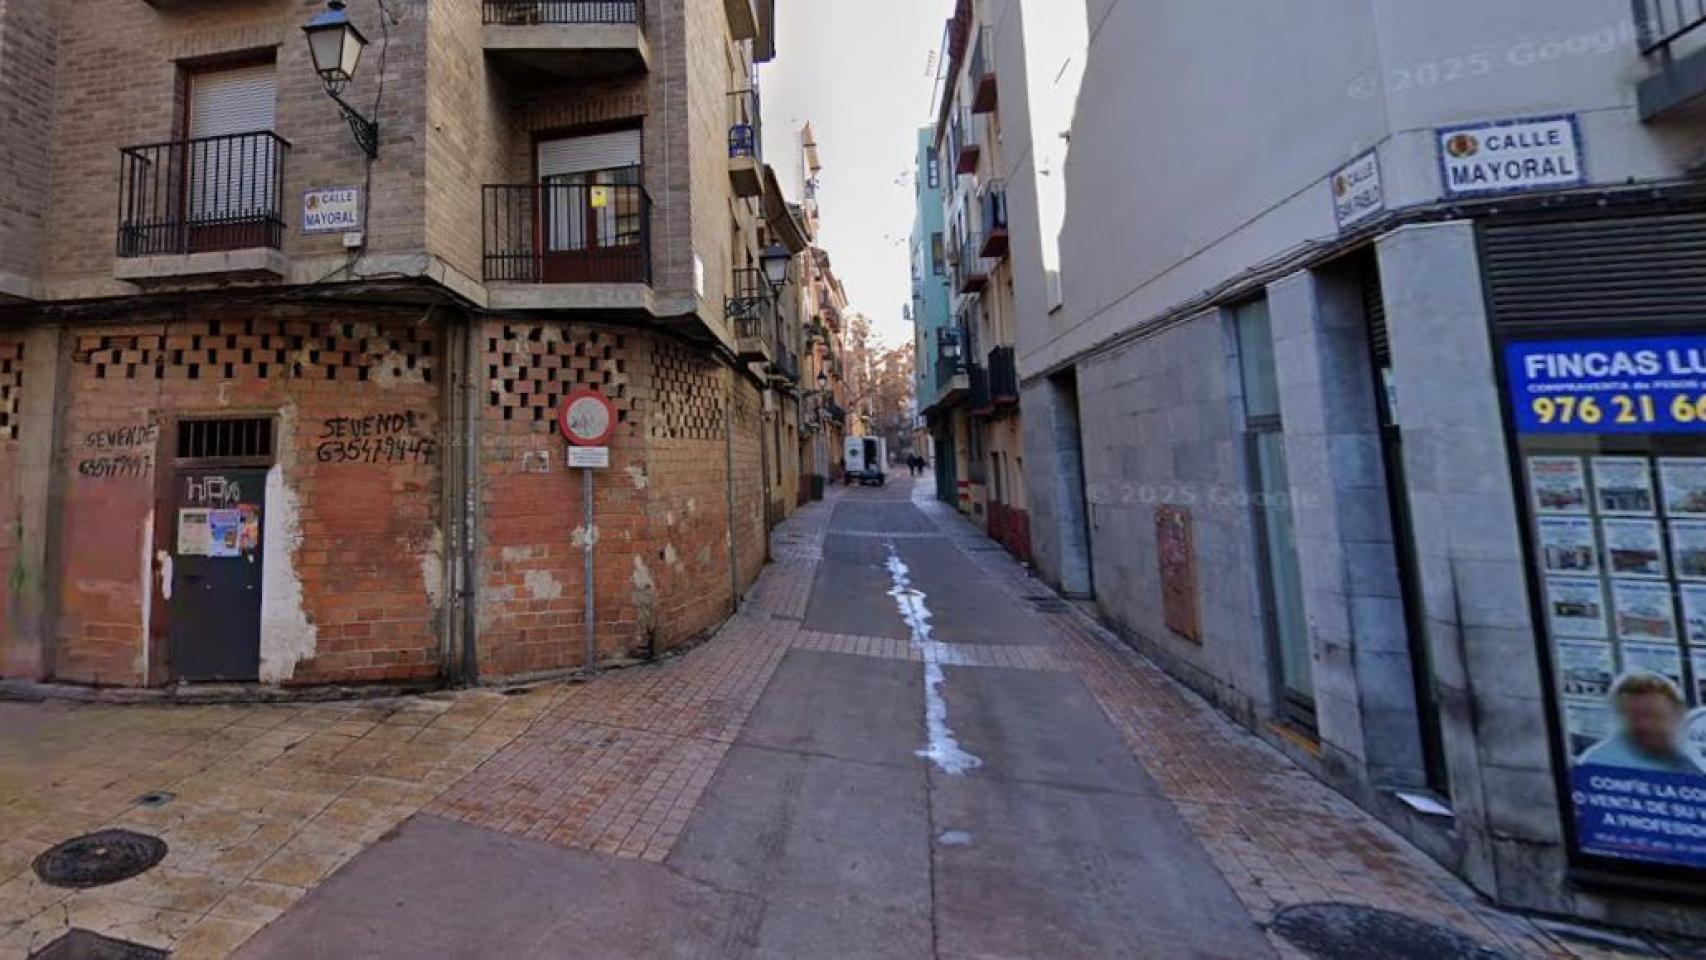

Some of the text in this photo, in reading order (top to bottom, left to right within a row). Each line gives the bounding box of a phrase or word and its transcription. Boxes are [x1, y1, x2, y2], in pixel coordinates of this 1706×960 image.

[1485, 129, 1561, 151] CALLE
[1451, 155, 1574, 185] MAYORAL
[321, 191, 353, 204] CALLE
[306, 211, 355, 226] MAYORAL
[1525, 351, 1661, 378] FINCAS
[1531, 394, 1603, 424] 976
[1610, 394, 1656, 424] 21
